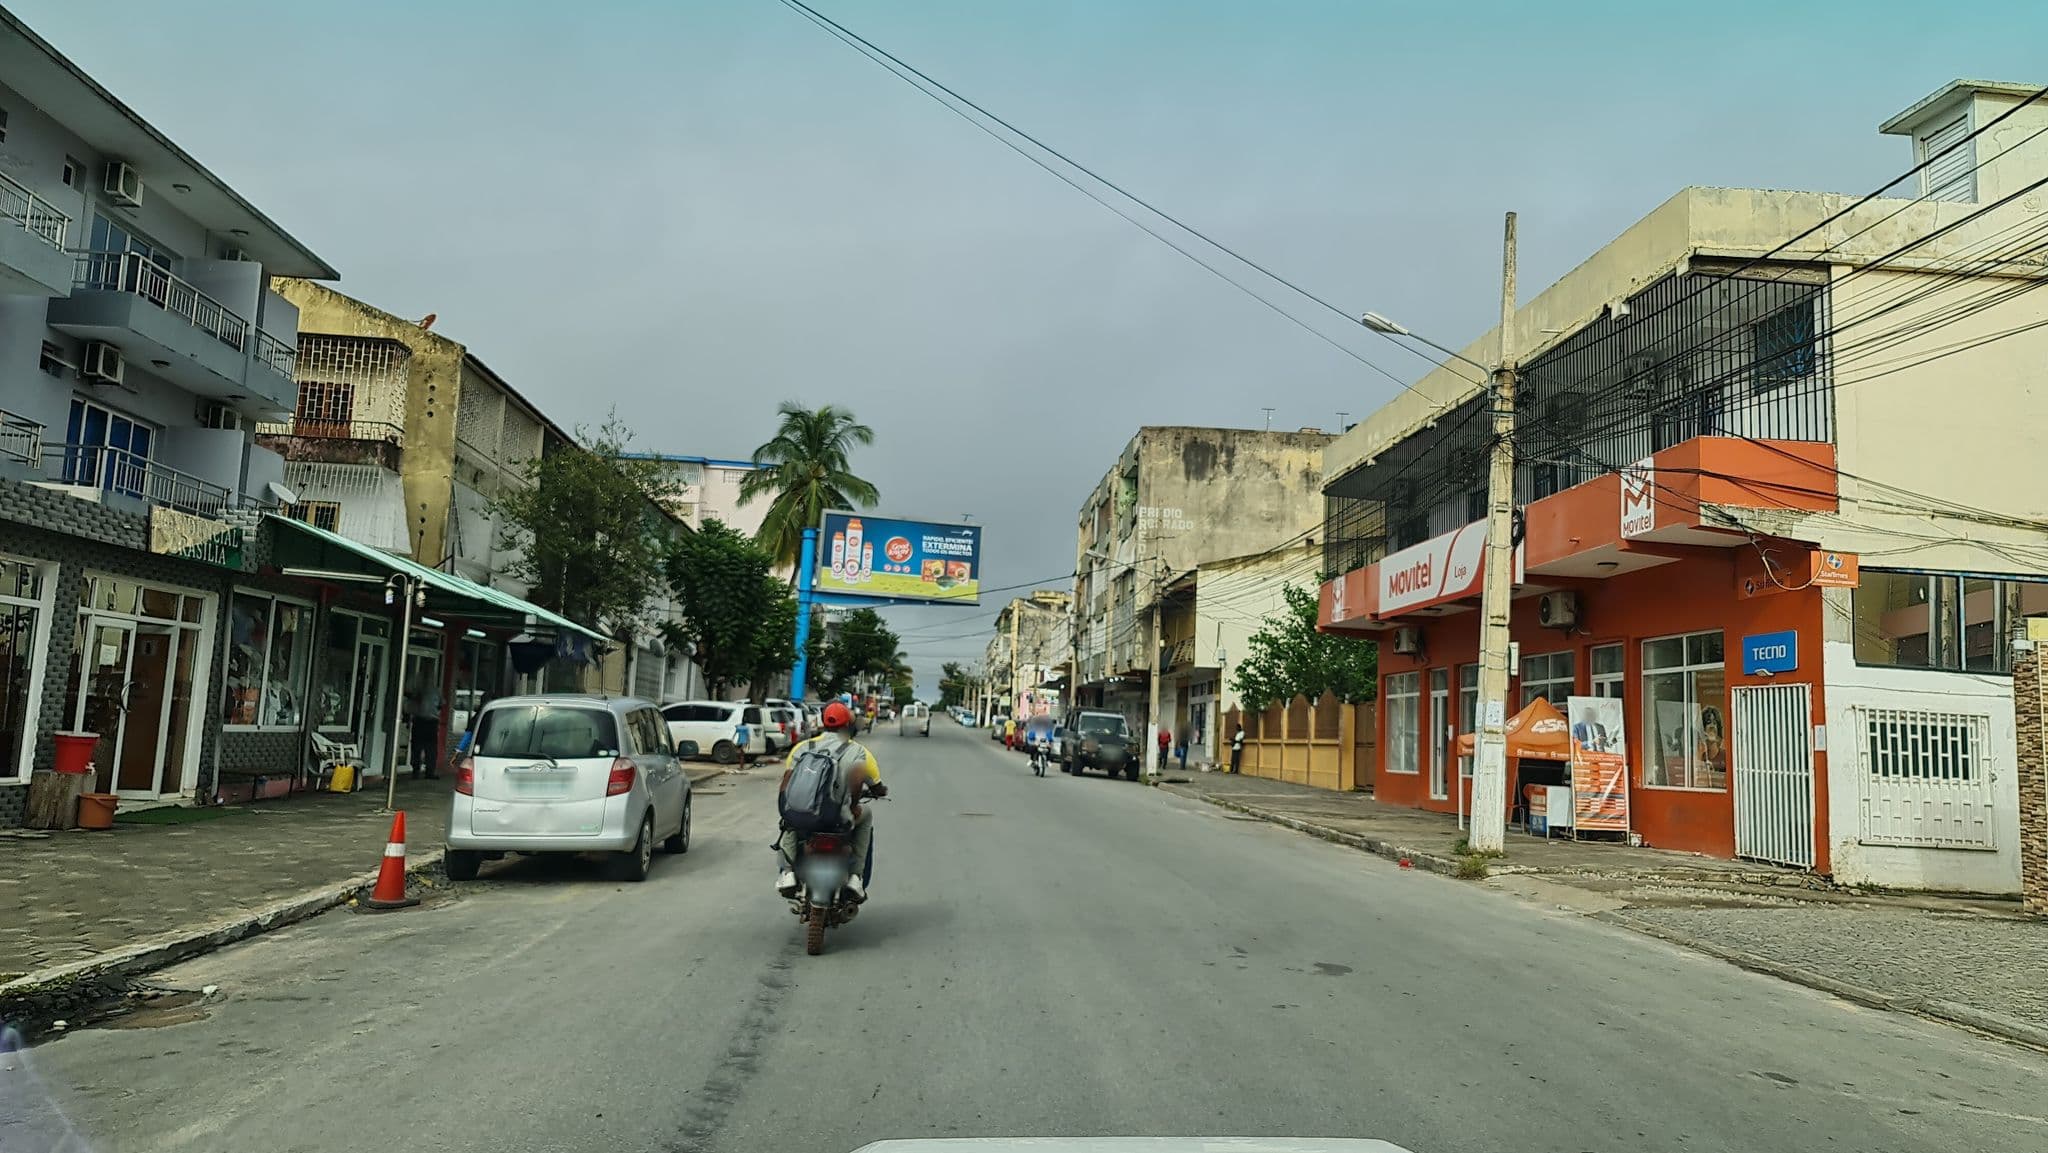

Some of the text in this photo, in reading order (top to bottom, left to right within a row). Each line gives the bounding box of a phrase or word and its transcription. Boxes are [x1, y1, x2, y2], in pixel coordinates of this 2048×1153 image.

[922, 541, 973, 552] EXTERMINA
[1454, 565, 1467, 580] Loja
[1752, 644, 1787, 661] TECNO
